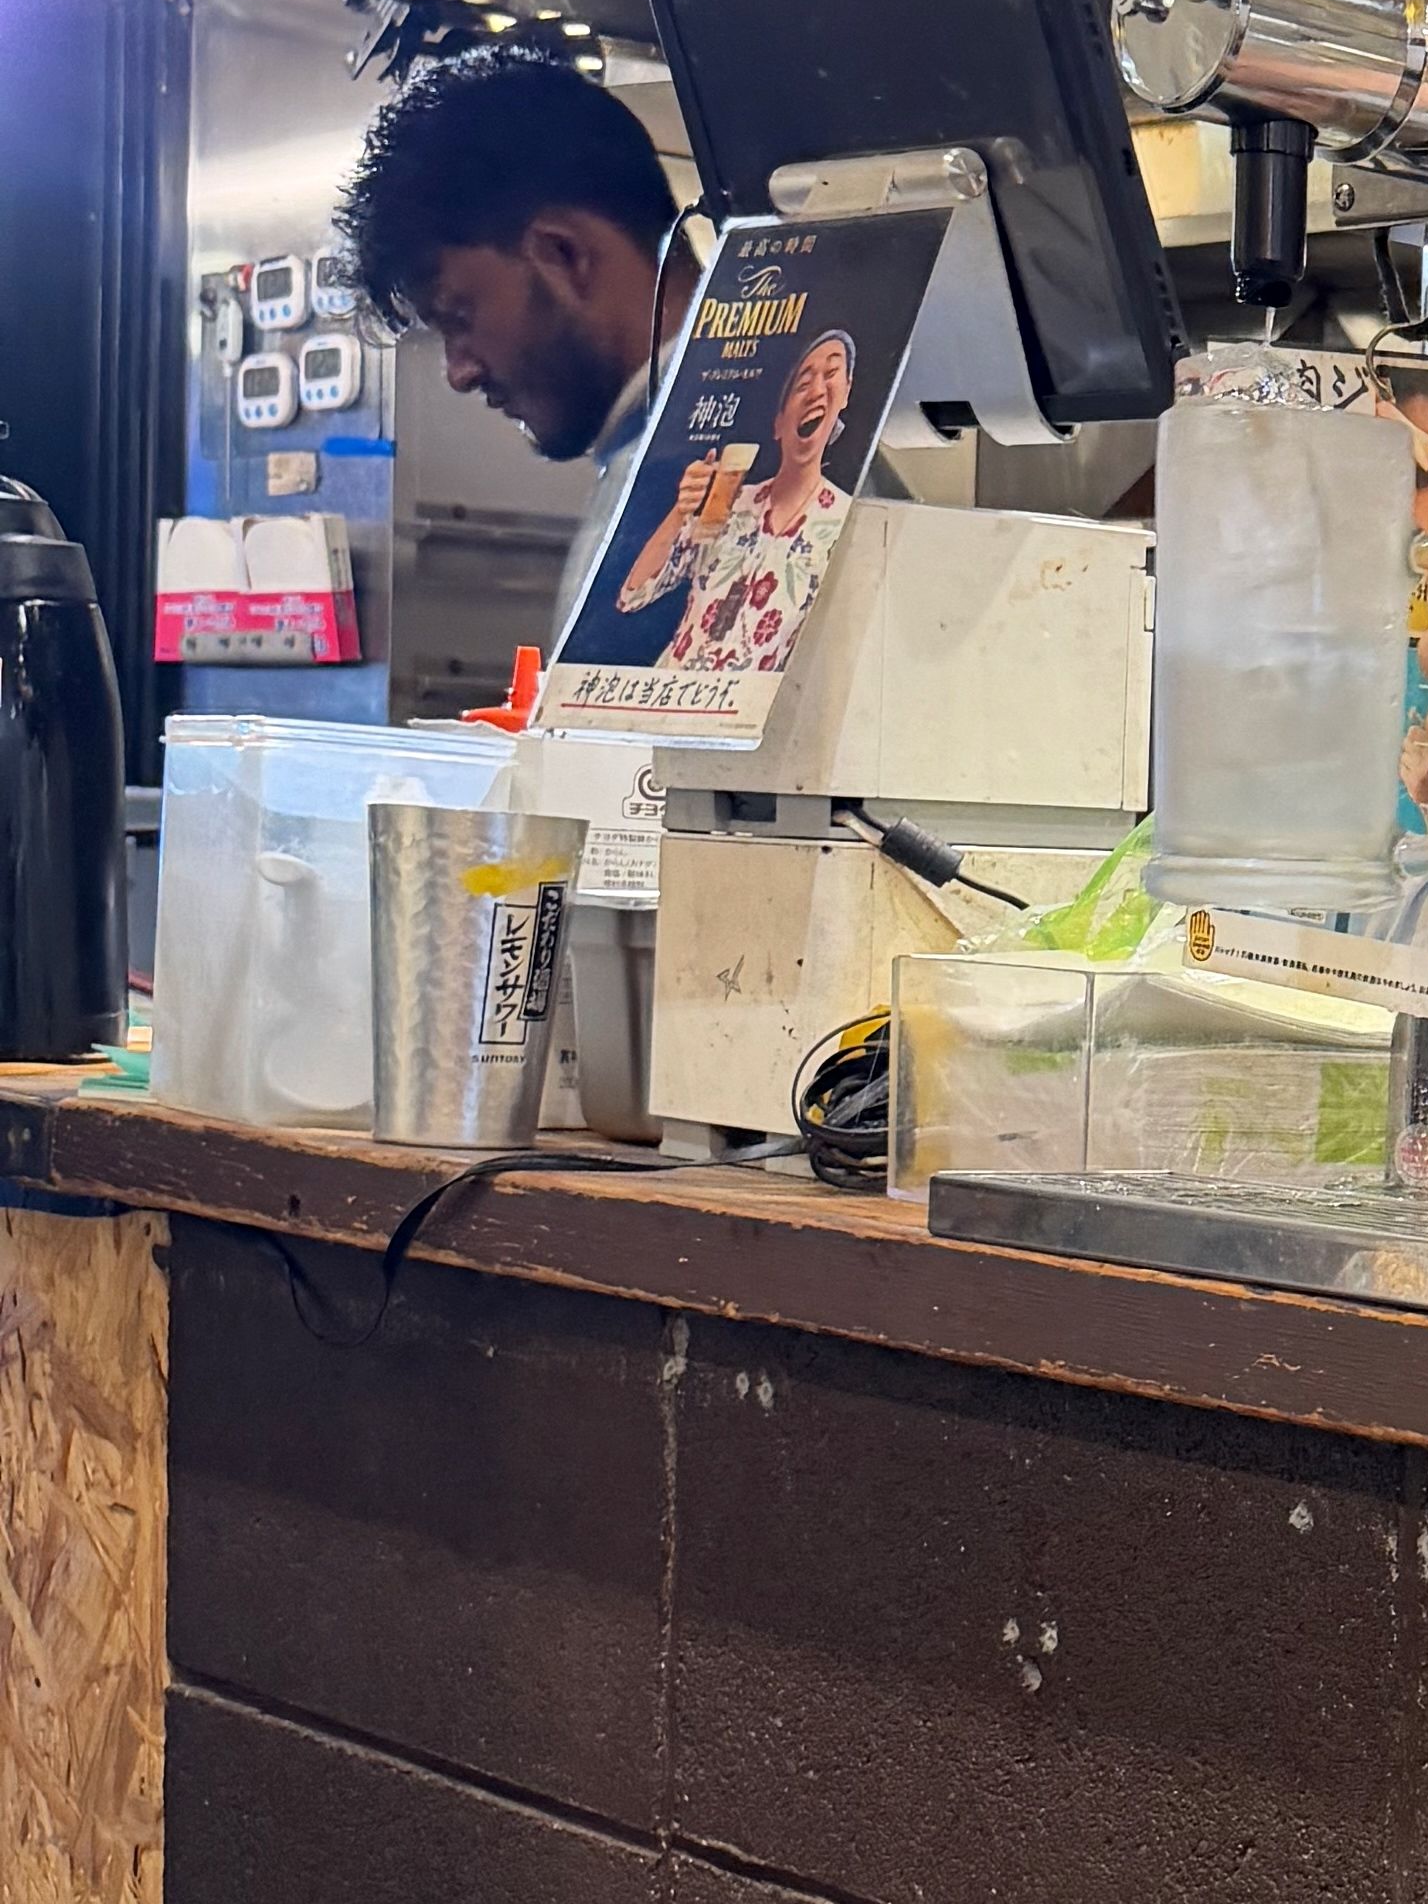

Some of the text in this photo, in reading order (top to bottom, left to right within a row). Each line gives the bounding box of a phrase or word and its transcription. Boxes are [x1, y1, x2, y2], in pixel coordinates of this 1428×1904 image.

[737, 264, 783, 300] The
[692, 291, 809, 340] PREMIUM
[688, 391, 741, 431] 神泡
[495, 913, 530, 1038] レモンサワー
